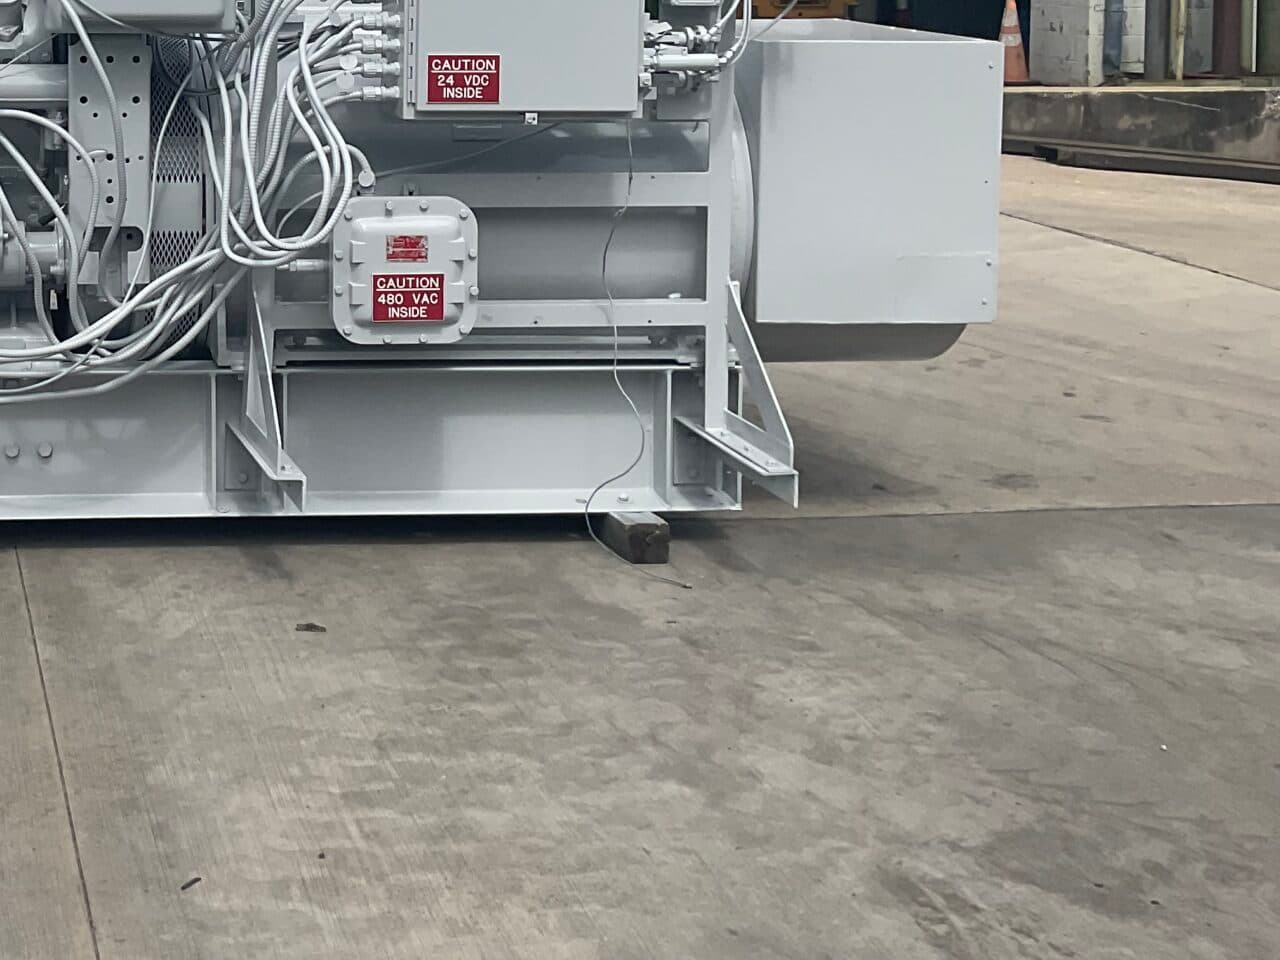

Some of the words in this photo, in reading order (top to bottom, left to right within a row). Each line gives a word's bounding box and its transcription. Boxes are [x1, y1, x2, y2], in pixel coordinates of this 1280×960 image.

[431, 59, 496, 71] CAUTION
[437, 74, 455, 86] 24
[464, 74, 490, 86] VDC
[443, 87, 484, 99] INSIDE
[376, 277, 440, 289] CAUTION
[377, 293, 404, 305] 480
[412, 292, 439, 305] VAC
[388, 306, 428, 318] INSIDE
